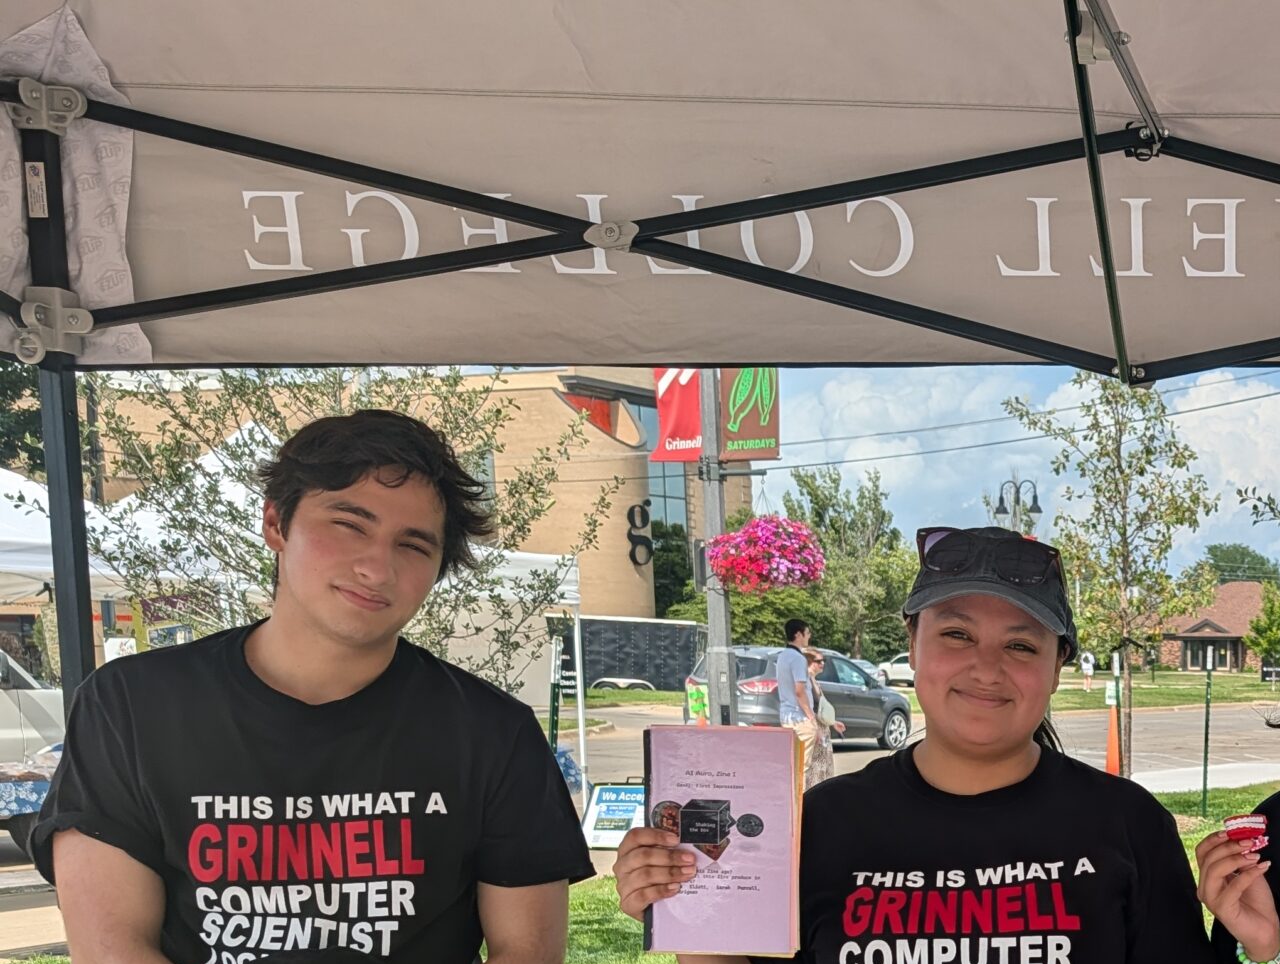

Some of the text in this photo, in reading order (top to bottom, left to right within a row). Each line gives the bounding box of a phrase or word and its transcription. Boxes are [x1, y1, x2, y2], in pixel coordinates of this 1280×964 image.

[726, 438, 776, 450] SATURDAYS
[627, 499, 653, 566] g
[191, 791, 448, 819] THIS IS WHAT A
[602, 792, 617, 800] We
[188, 819, 425, 883] GRINNELL
[852, 857, 1096, 889] THIS IS WHAT A
[196, 881, 415, 917] COMPUTER
[843, 883, 1080, 937] GRINNELL
[199, 913, 399, 957] SCIENTIST
